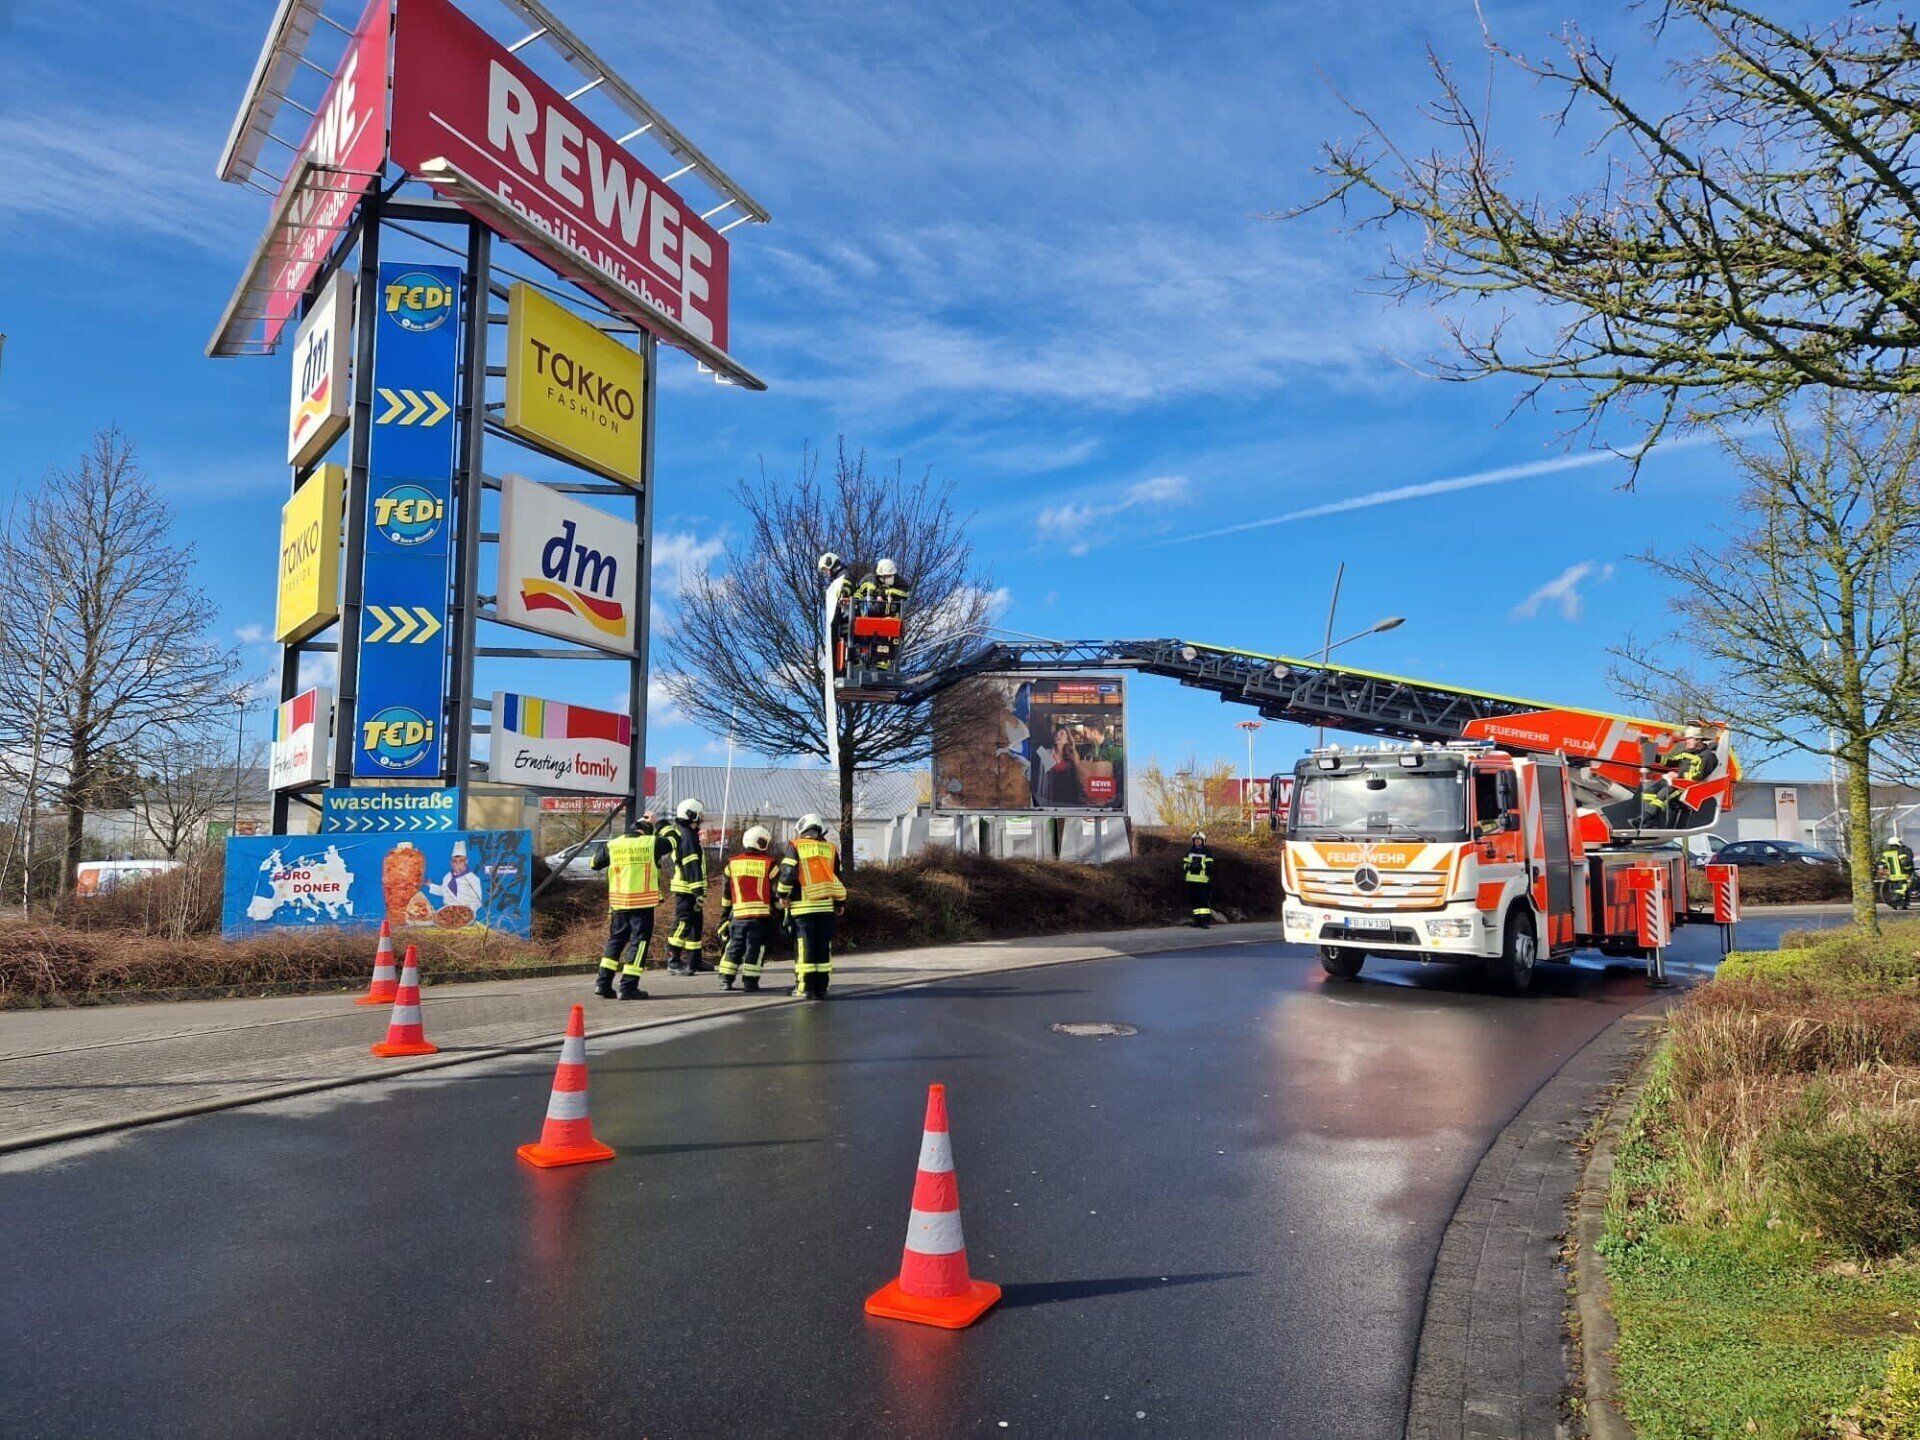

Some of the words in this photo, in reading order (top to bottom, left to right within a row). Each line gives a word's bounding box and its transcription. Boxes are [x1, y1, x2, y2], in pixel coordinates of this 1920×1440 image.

[302, 328, 329, 402] dm
[547, 387, 619, 433] FASHION
[541, 519, 617, 598] dm
[1484, 723, 1550, 743] FEUERWEHR
[1563, 737, 1597, 750] FULDA
[514, 749, 572, 779] Ernsting's
[575, 753, 618, 782] family
[329, 792, 454, 810] waschstraße
[1326, 852, 1406, 863] FEUERWEHR
[273, 871, 311, 881] EURO
